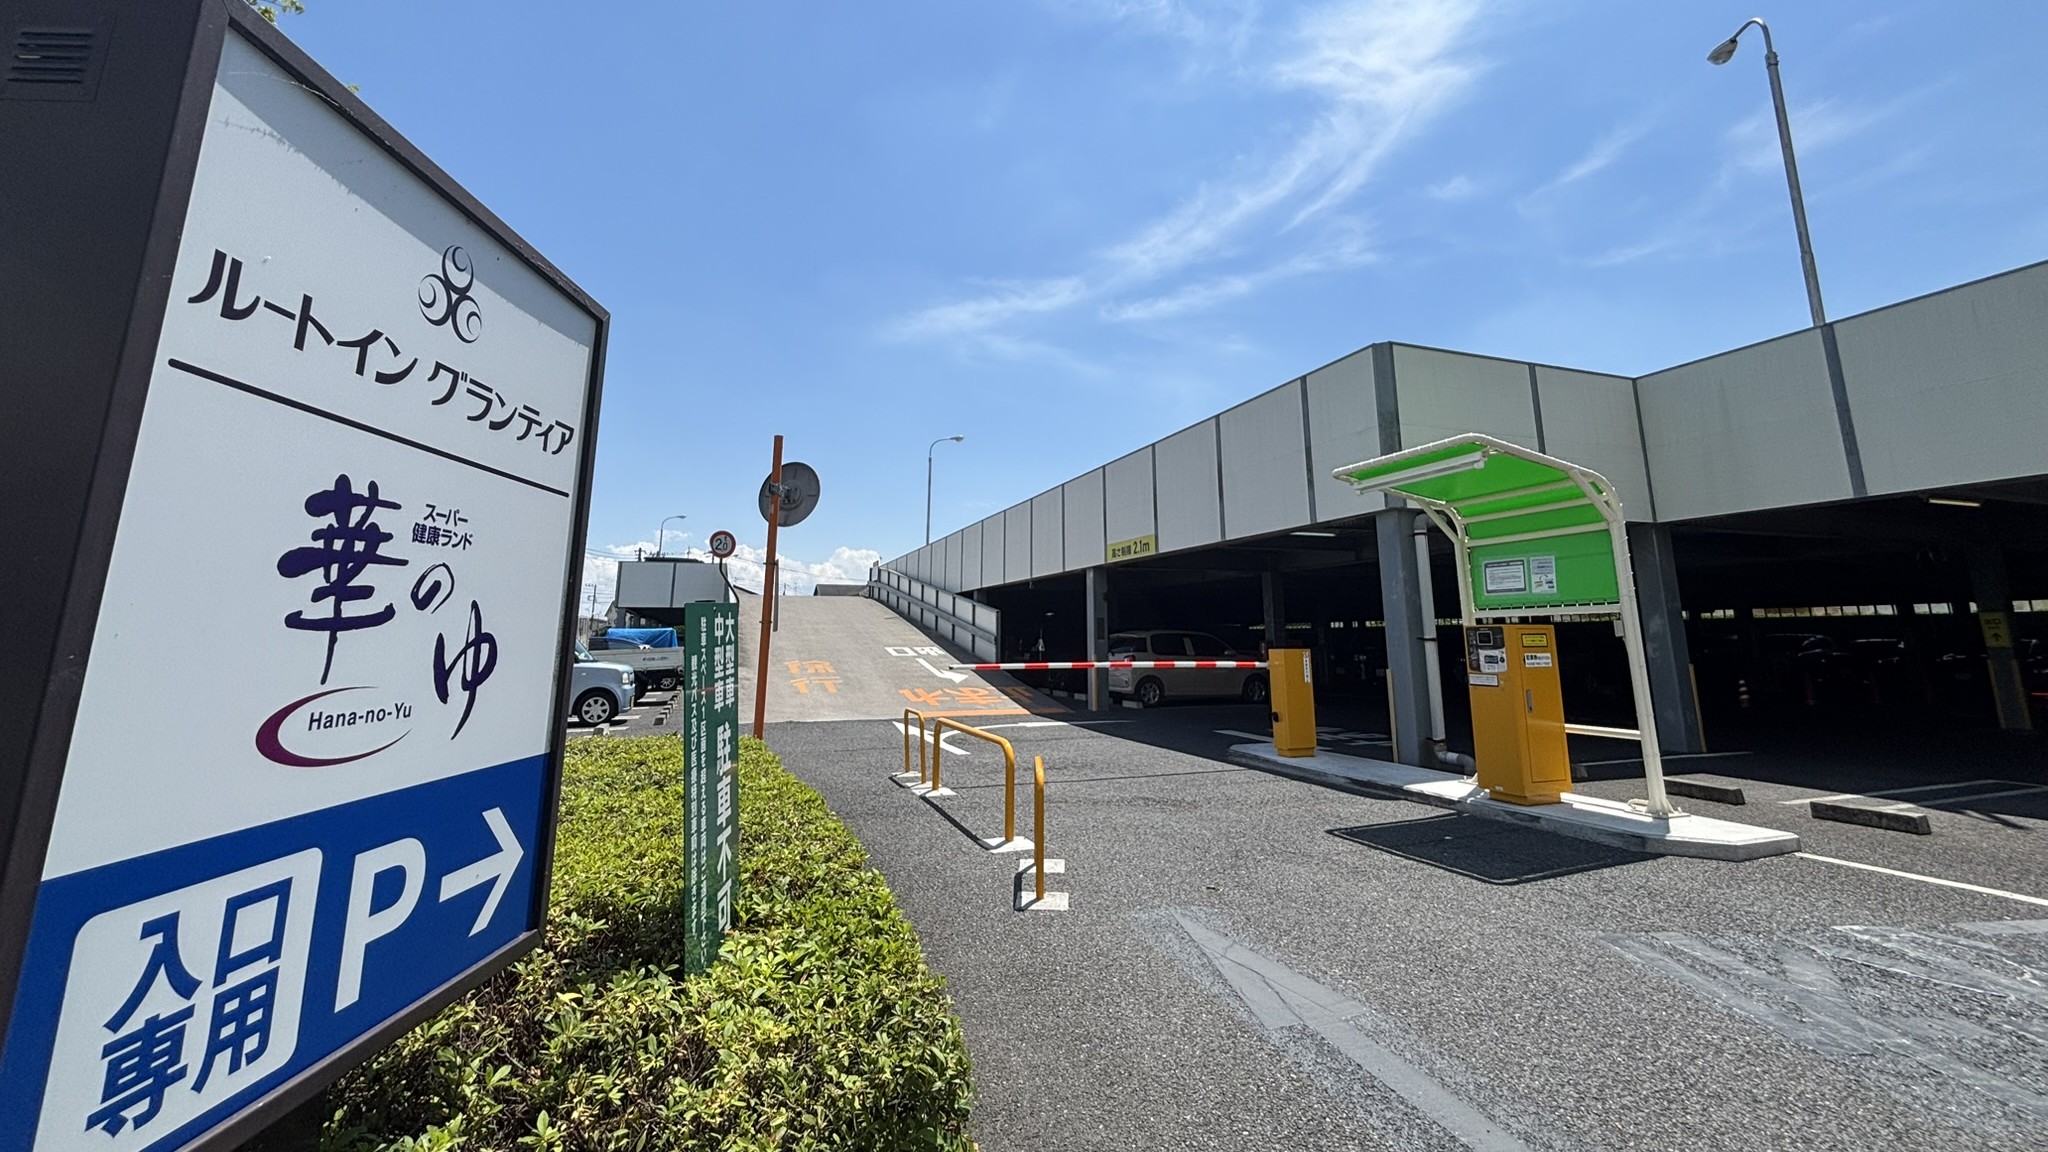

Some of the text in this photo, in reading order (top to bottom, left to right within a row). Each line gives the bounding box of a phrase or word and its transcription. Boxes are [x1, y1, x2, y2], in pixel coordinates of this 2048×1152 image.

[187, 248, 574, 456] ルートイン グランティア
[411, 523, 473, 550] 健康ランド
[423, 503, 469, 525] スーパー
[1133, 540, 1150, 555] 2.1m
[277, 473, 498, 741] 華のゆ
[714, 612, 725, 713] 中型車
[725, 612, 735, 709] 大型車
[307, 702, 413, 732] Hana-no-Yu
[716, 721, 733, 935] 駐車不可
[102, 837, 427, 1034] 入口 P
[85, 966, 279, 1138] 専用
